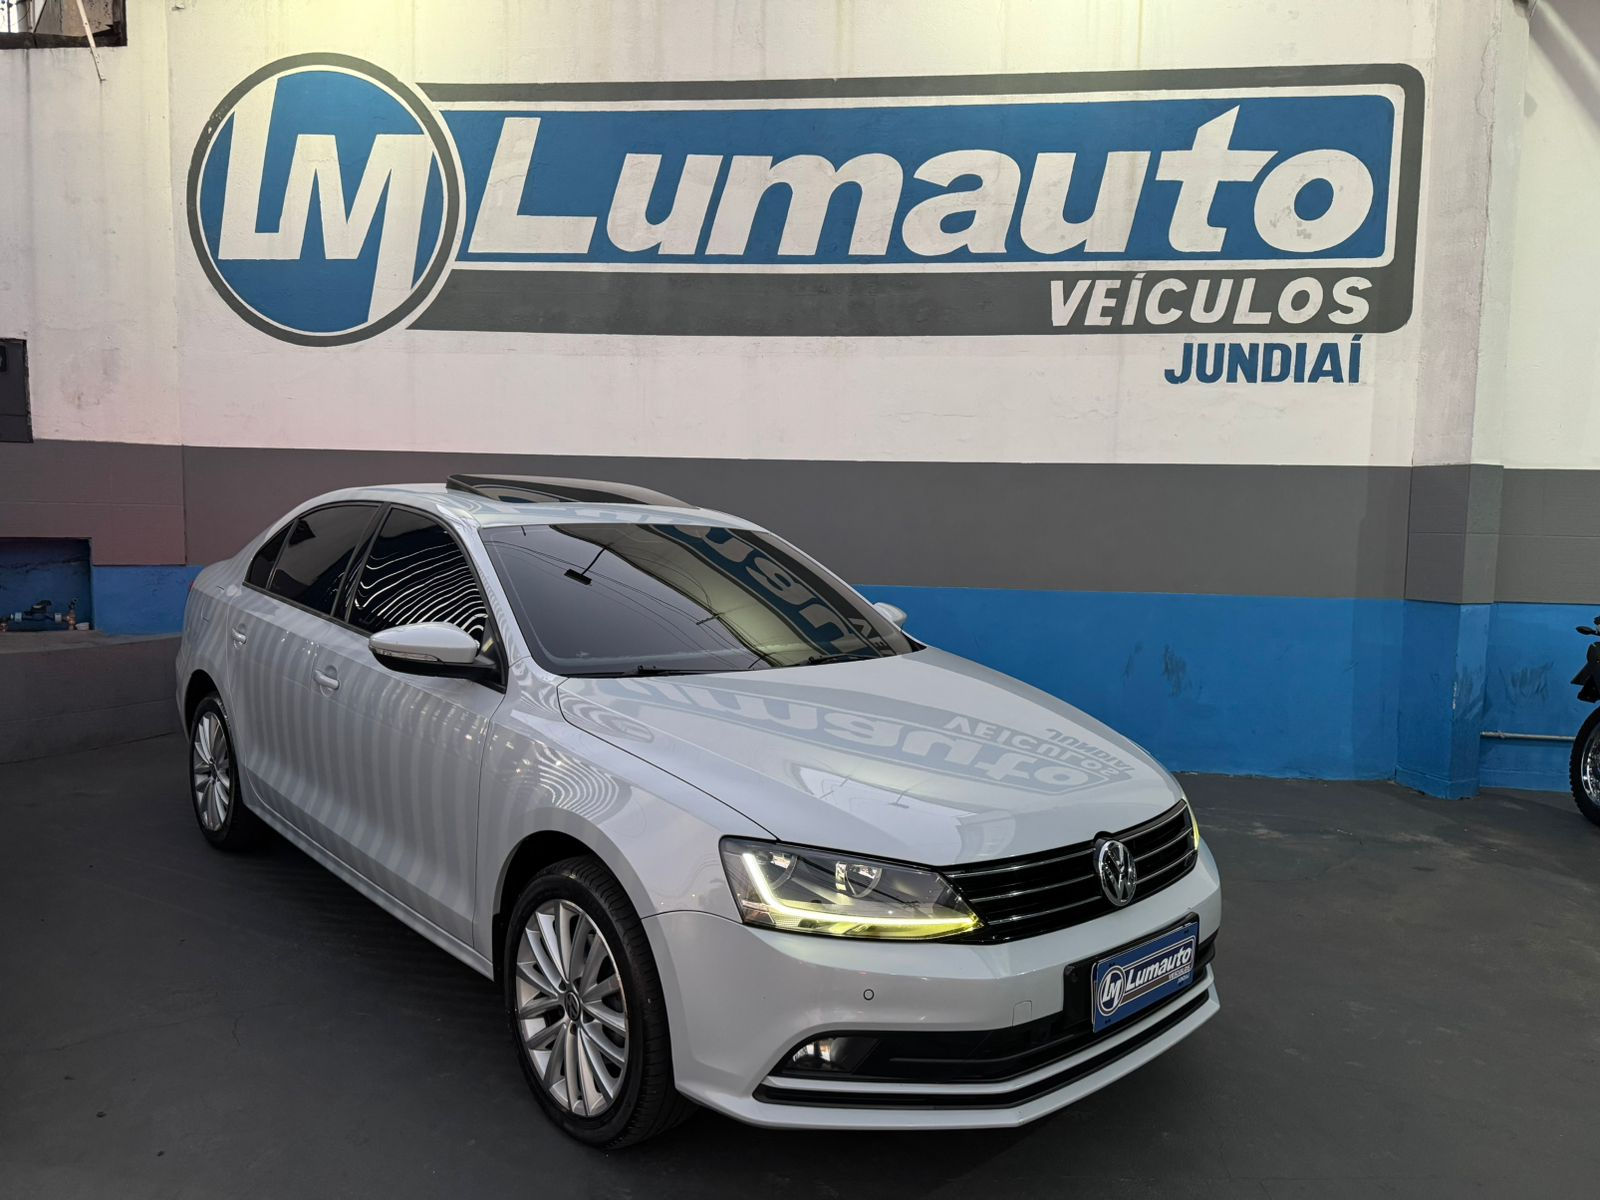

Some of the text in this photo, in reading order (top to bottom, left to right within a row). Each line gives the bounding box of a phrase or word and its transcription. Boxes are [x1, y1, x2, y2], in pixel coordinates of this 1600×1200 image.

[218, 74, 1375, 323] LM Lumauto
[1050, 272, 1373, 327] VEÍCULOS
[1164, 334, 1363, 385] JUNDIAÍ
[1102, 946, 1193, 1008] LM Lumauto
